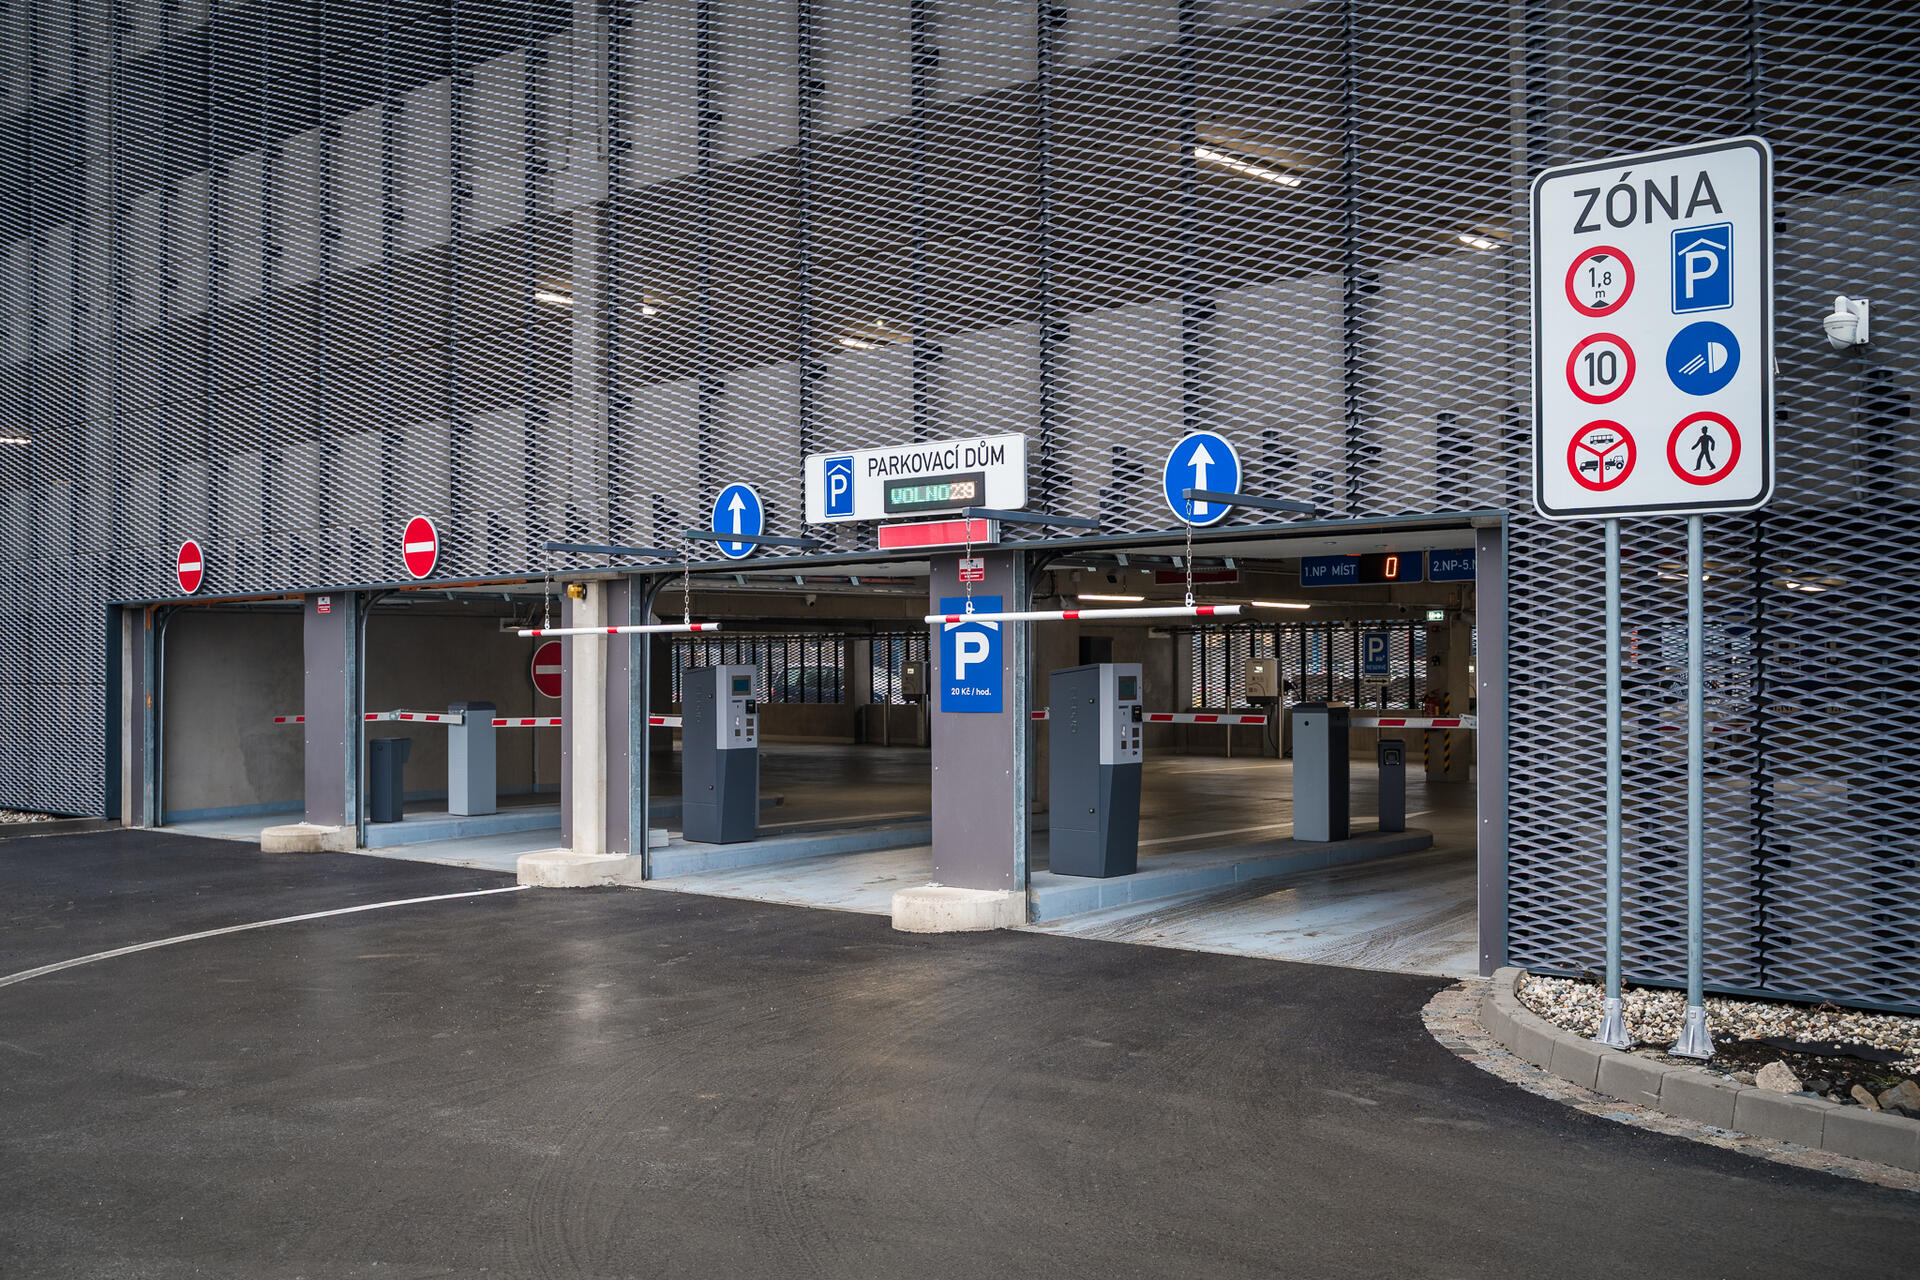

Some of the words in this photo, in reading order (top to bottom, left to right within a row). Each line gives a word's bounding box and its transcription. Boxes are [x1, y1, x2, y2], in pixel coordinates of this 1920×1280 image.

[1573, 170, 1723, 234] ZÓNA
[1588, 267, 1612, 288] 1,8
[1685, 250, 1719, 299] P
[1595, 290, 1606, 299] m
[1584, 350, 1617, 387] 10
[868, 445, 959, 478] PARKOVACÍ
[965, 441, 1005, 468] DŮM
[831, 474, 848, 507] P
[1305, 565, 1327, 577] 1.NP
[1331, 562, 1357, 576] MÍST
[1385, 557, 1398, 577] 0
[956, 631, 990, 680] P
[1368, 637, 1384, 662] P
[951, 688, 960, 696] 20
[961, 687, 971, 696] Kč
[976, 688, 992, 696] hod.
